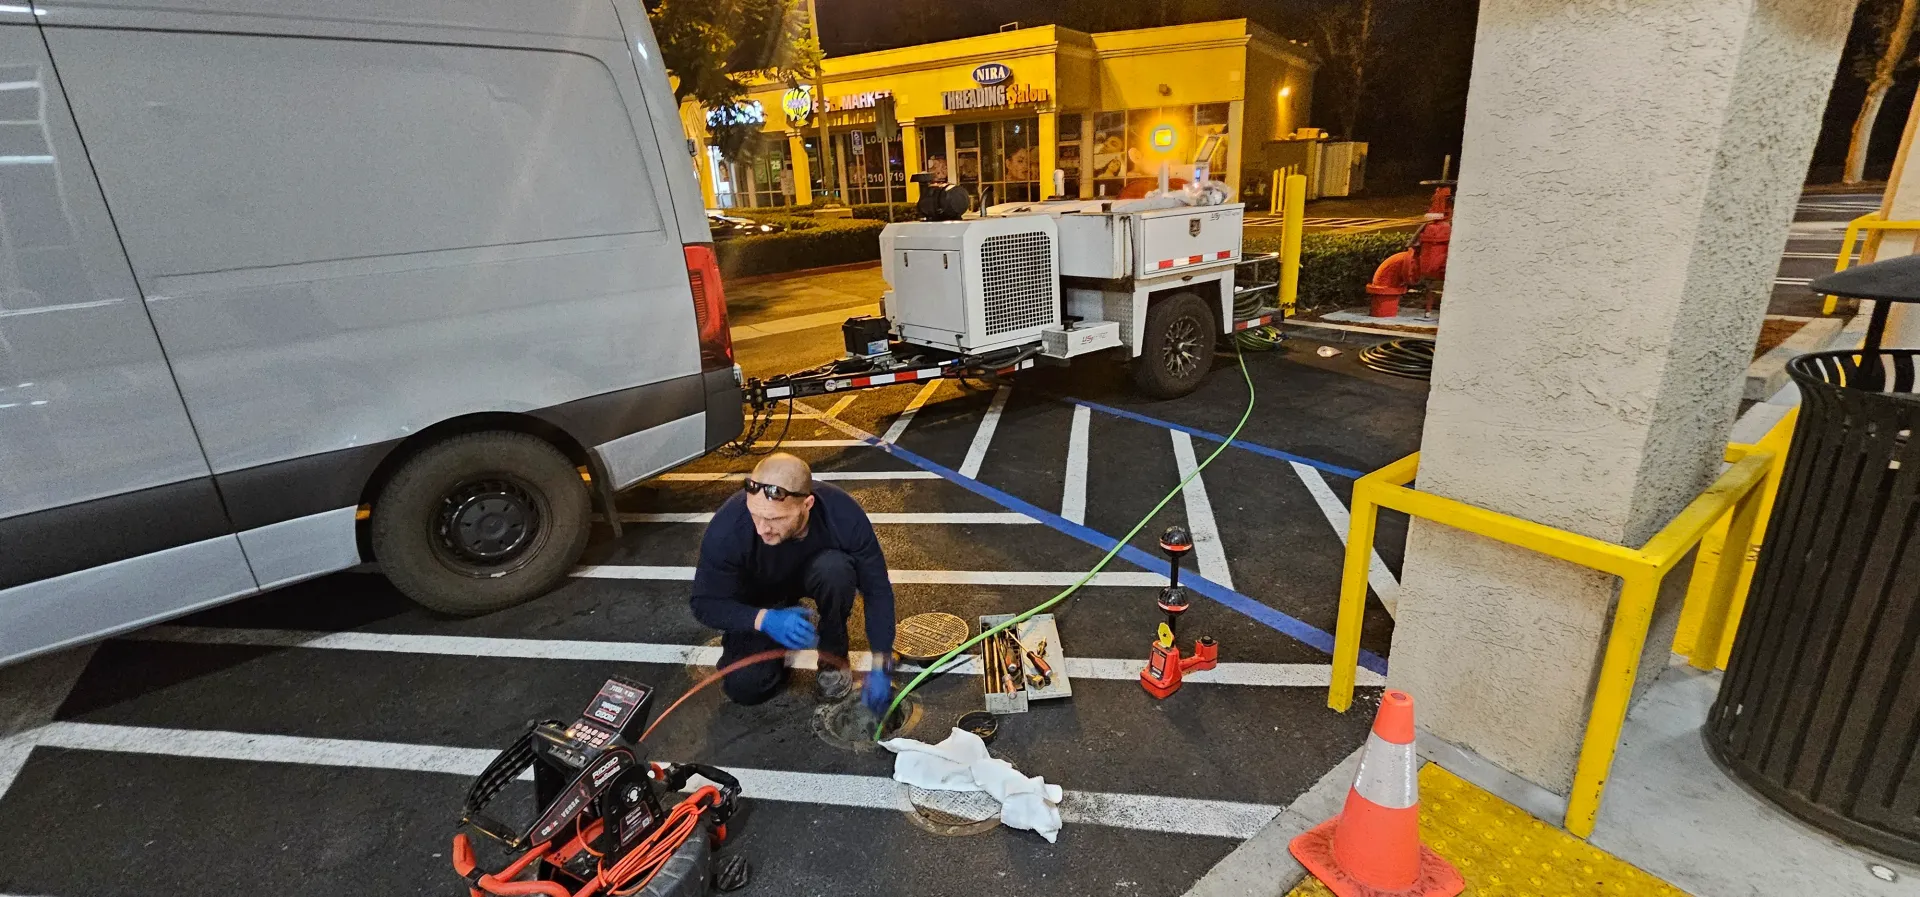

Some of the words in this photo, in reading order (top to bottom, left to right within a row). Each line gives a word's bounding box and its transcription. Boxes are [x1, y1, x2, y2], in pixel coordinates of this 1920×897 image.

[976, 66, 1006, 81] NIRA
[941, 85, 1005, 110] THREADING
[1006, 84, 1048, 109] Salon
[592, 757, 618, 780] RIDGID
[560, 795, 580, 818] VERSA
